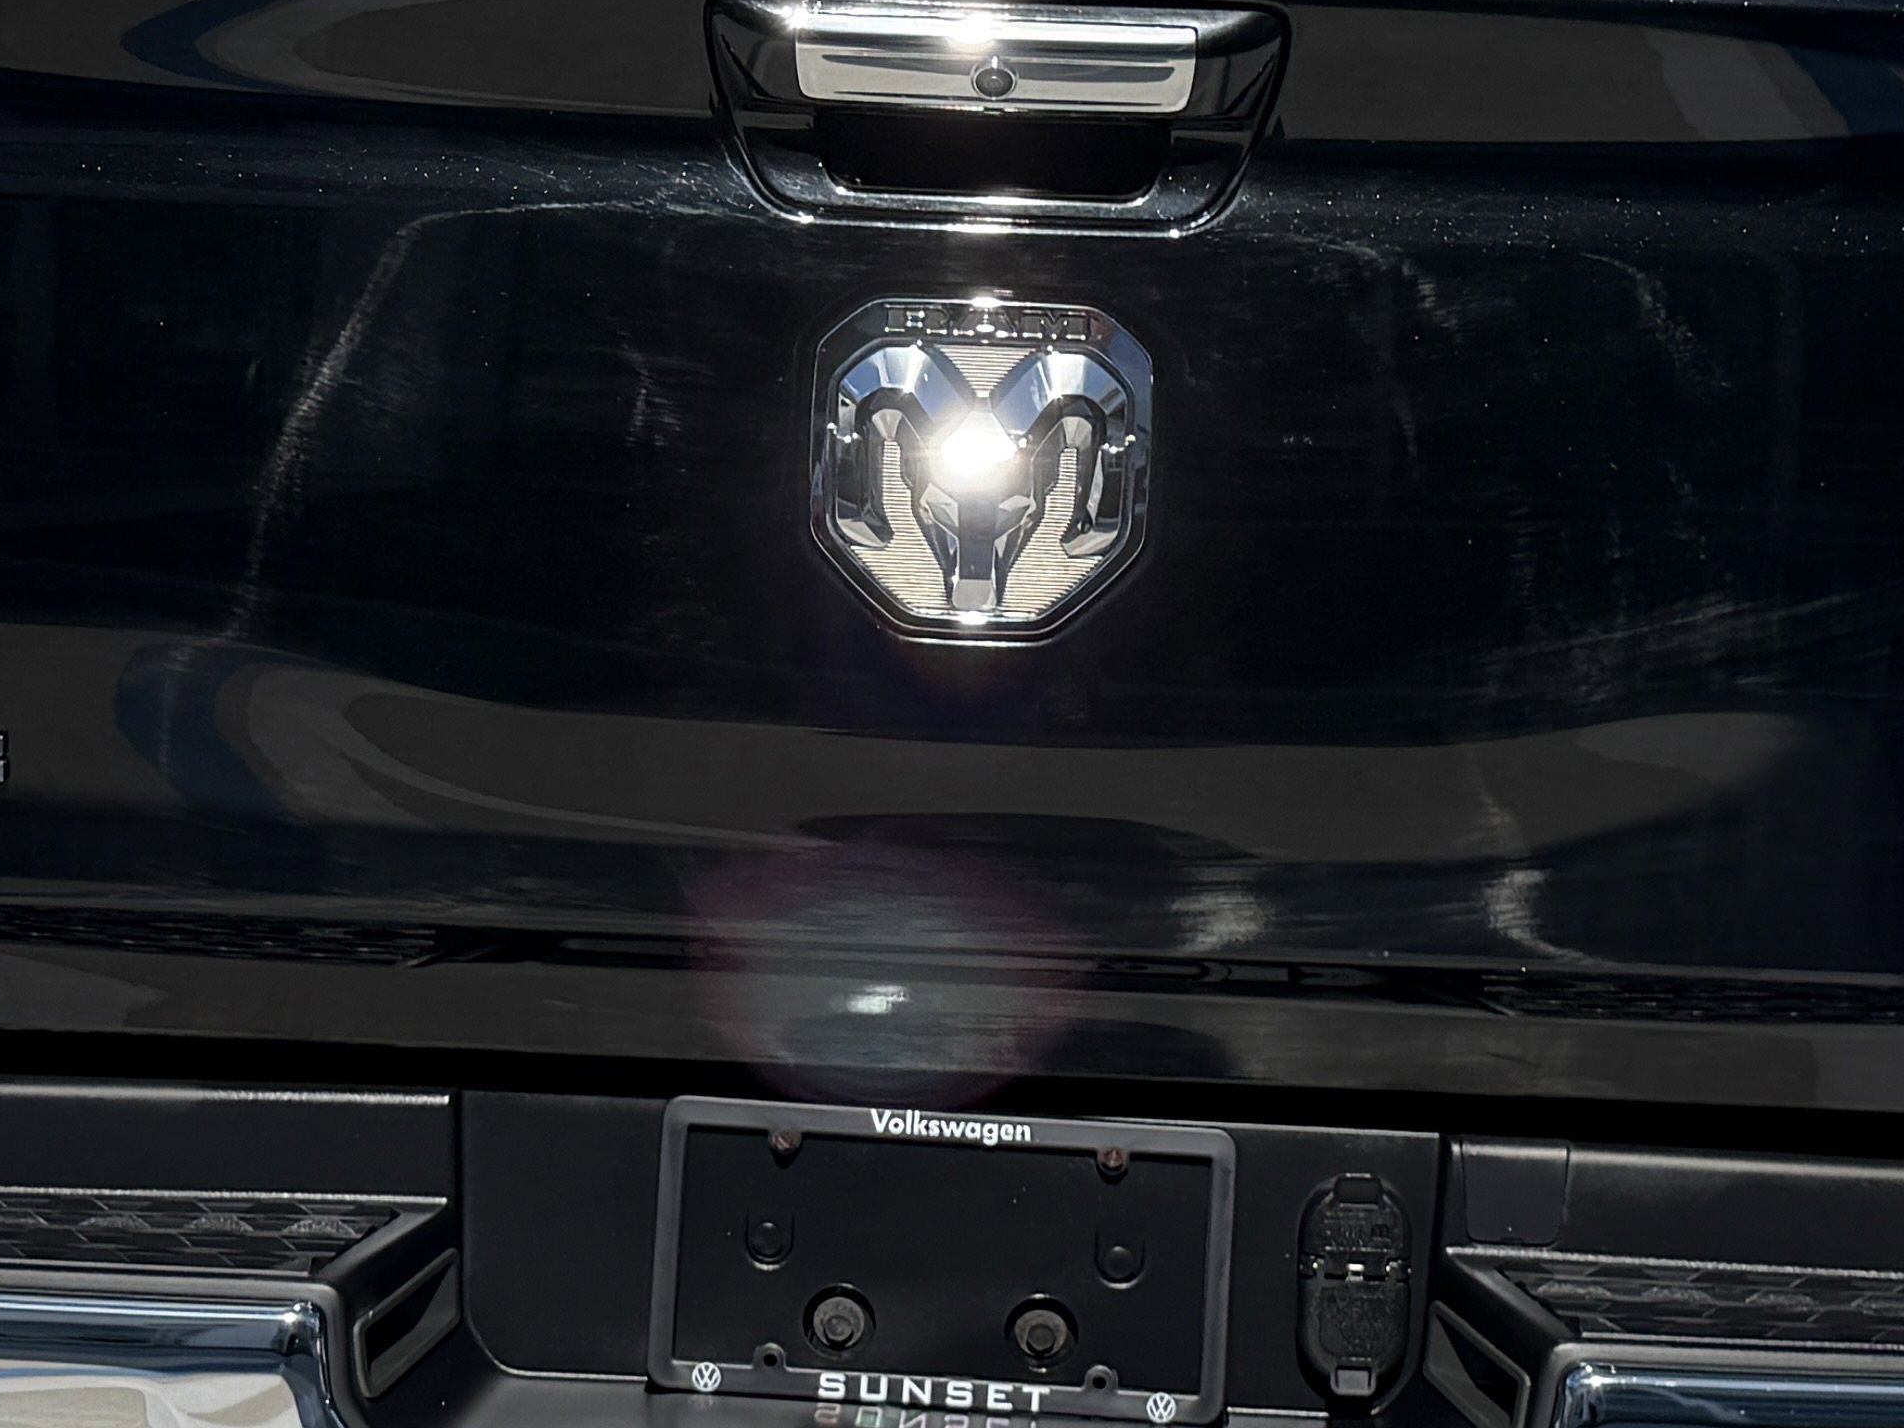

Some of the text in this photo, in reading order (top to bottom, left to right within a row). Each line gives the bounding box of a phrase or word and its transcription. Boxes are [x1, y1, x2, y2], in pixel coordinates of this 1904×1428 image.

[884, 303, 1089, 341] RAM
[870, 1108, 1031, 1146] Volkswagen
[817, 1372, 1050, 1413] SUNSET
